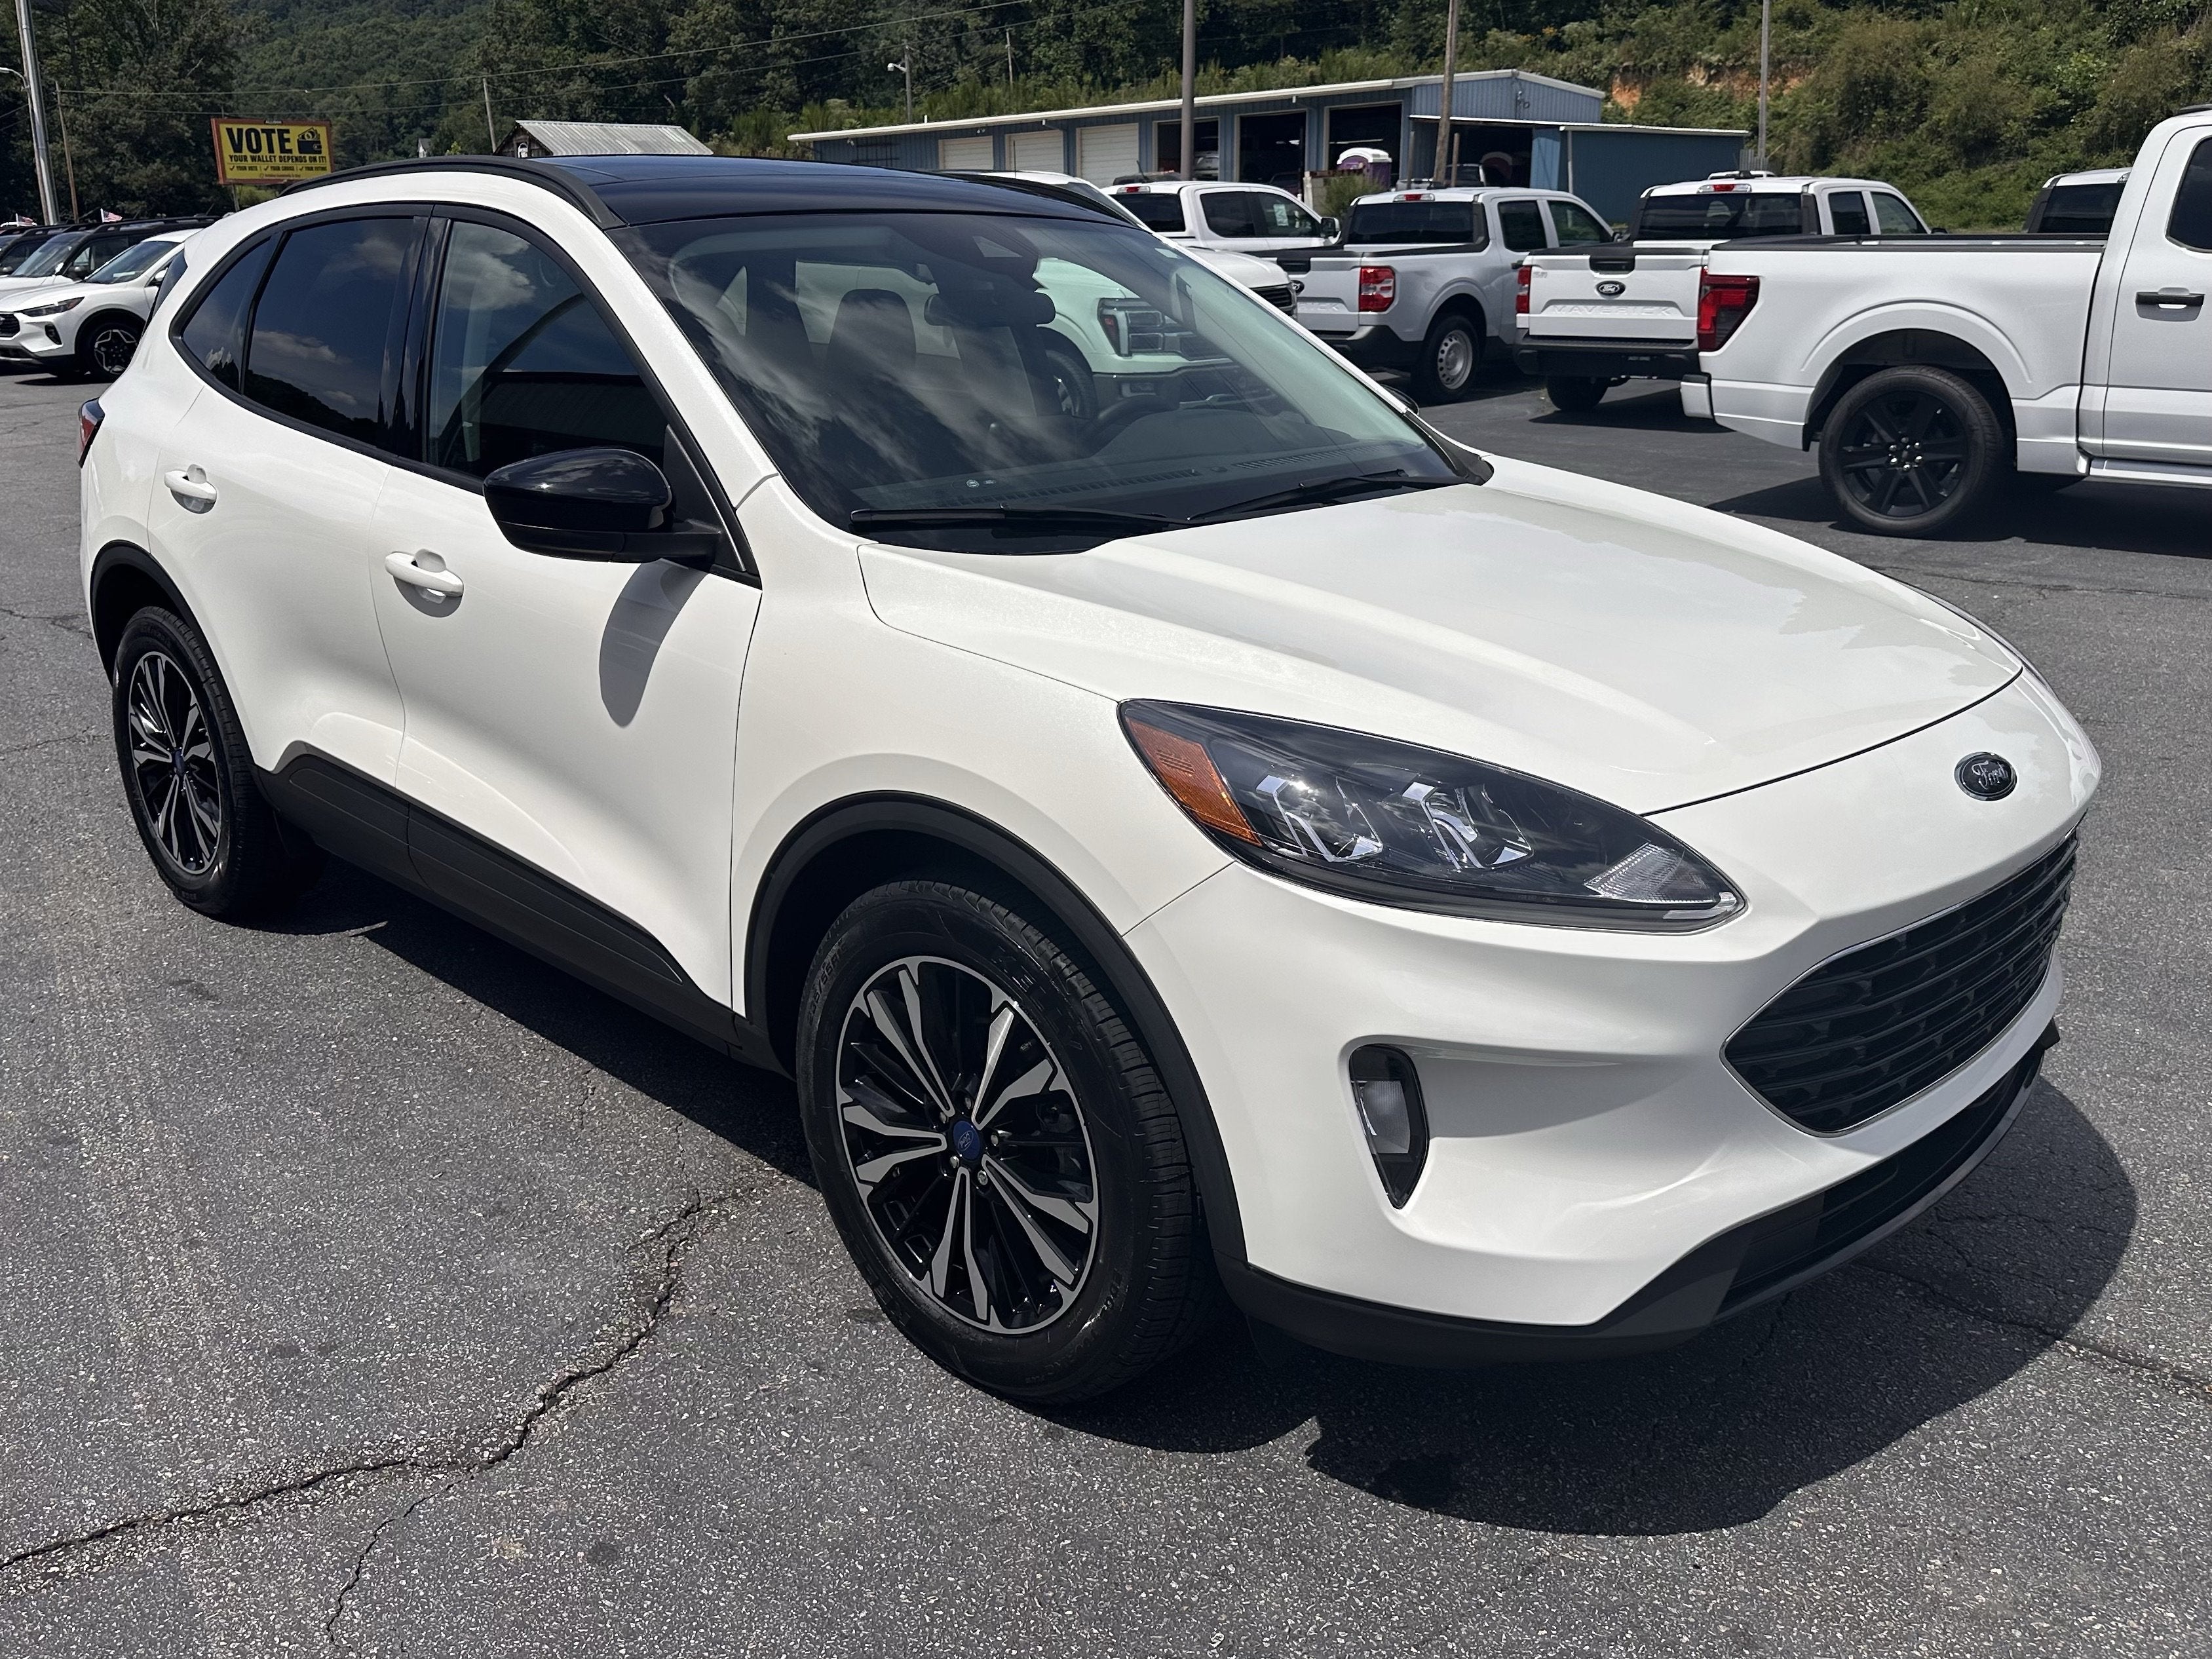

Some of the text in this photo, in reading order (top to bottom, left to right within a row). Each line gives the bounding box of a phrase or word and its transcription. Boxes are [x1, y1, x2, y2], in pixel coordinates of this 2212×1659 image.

[226, 127, 293, 154] VOTE
[278, 155, 307, 163] DEPENDS
[1553, 305, 1673, 316] MAVERICK
